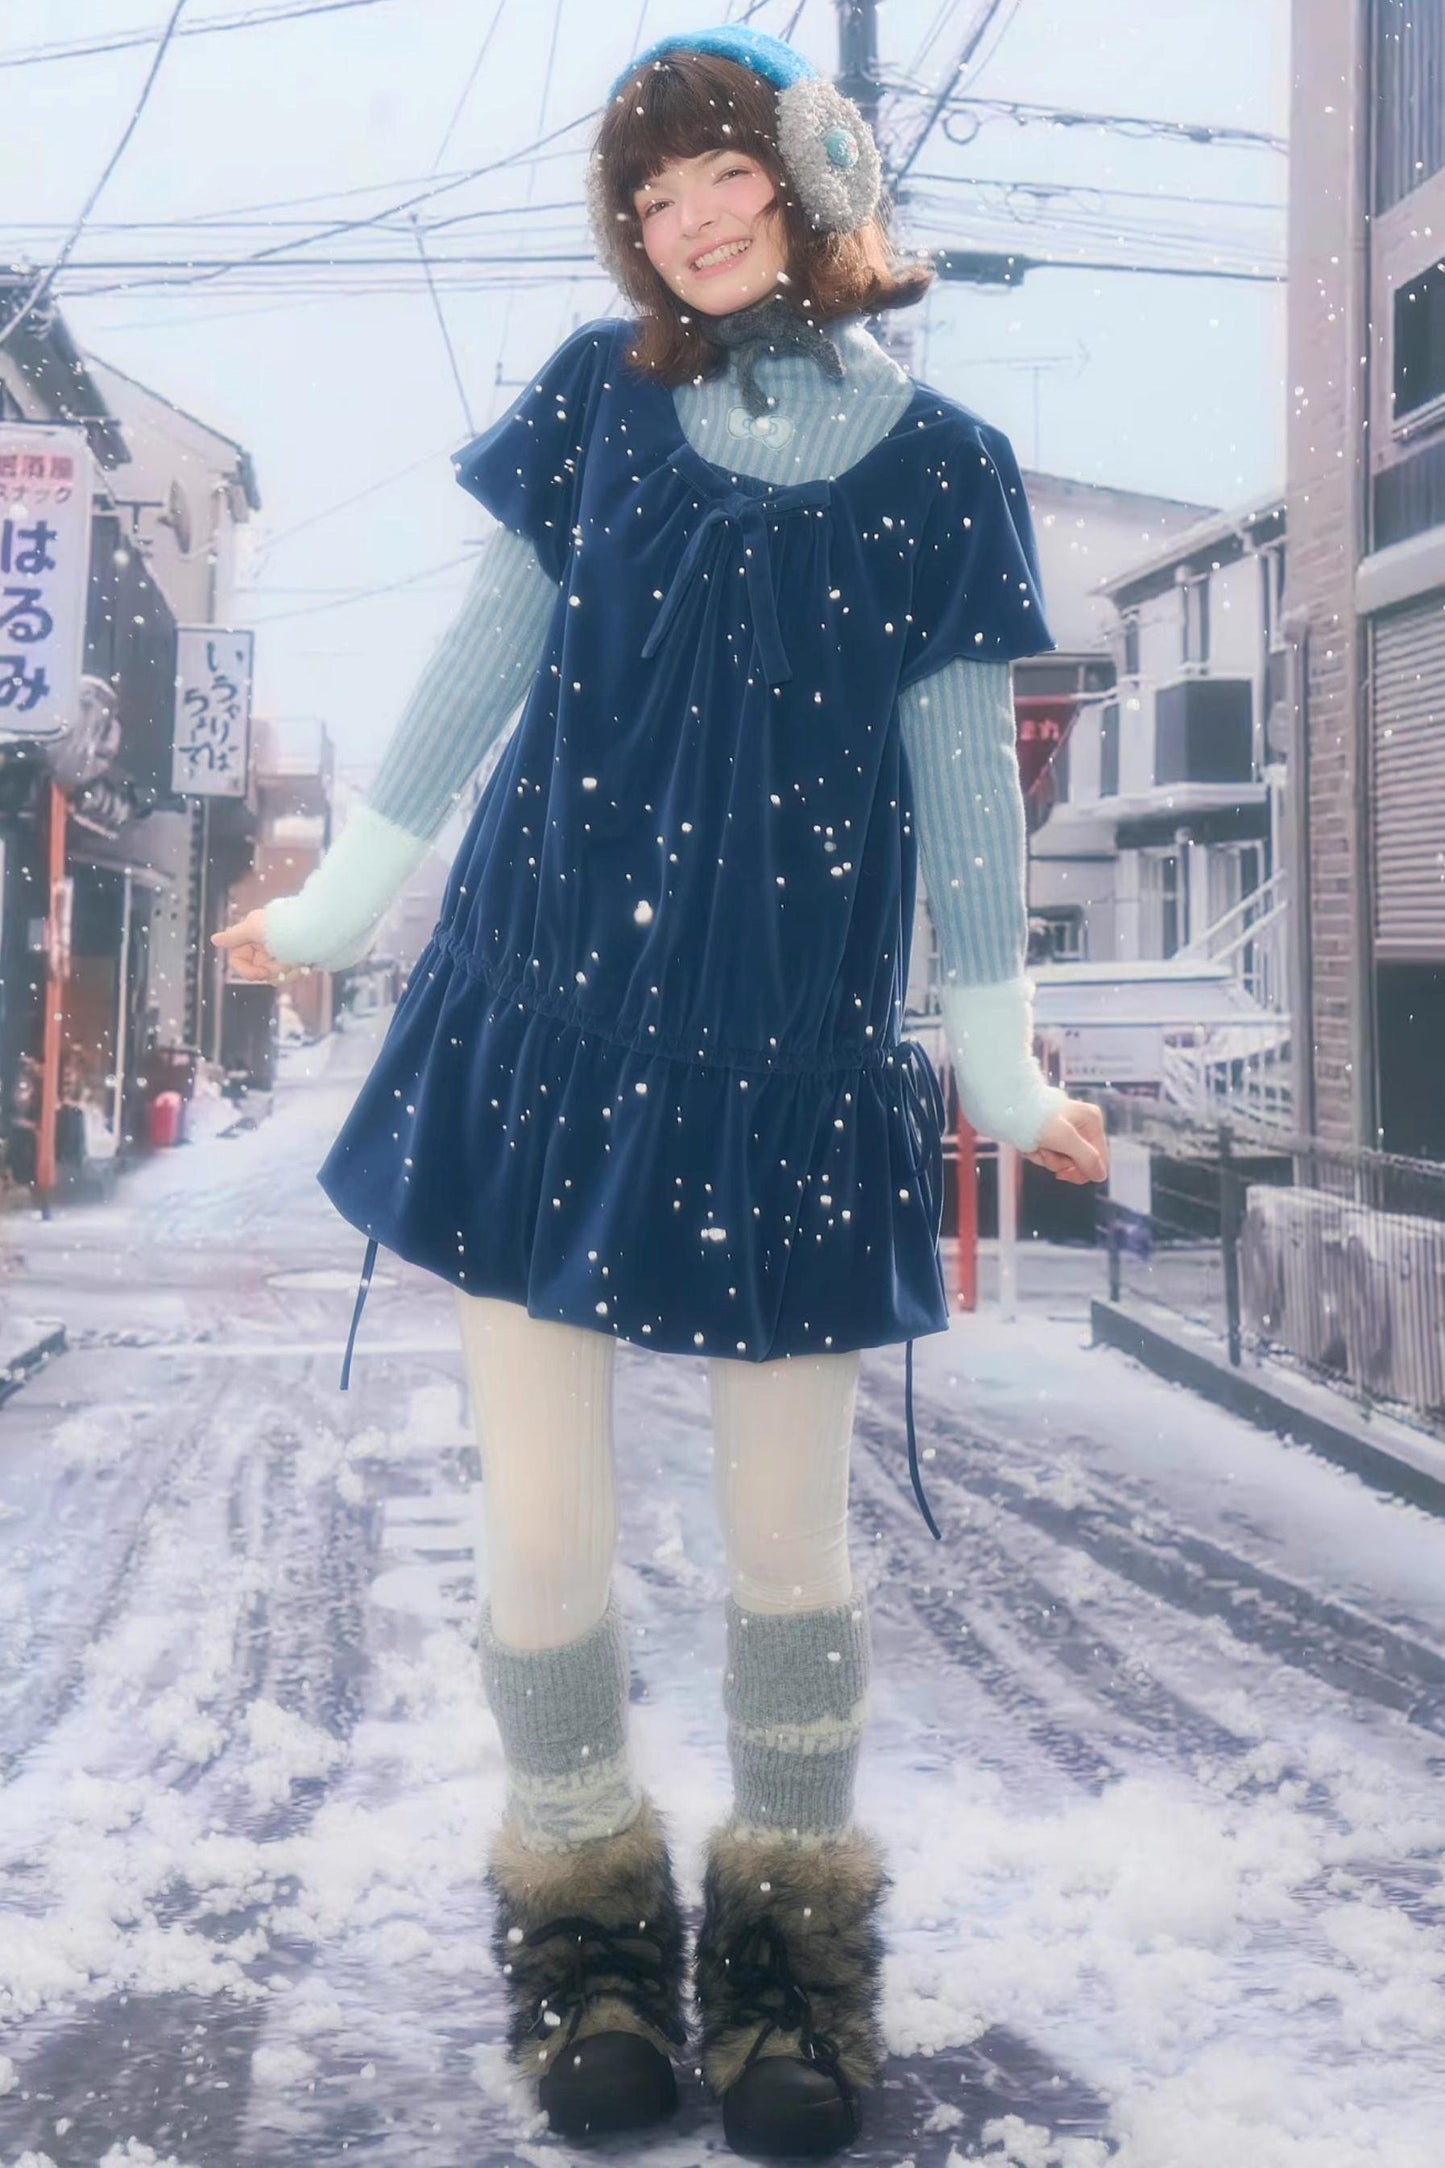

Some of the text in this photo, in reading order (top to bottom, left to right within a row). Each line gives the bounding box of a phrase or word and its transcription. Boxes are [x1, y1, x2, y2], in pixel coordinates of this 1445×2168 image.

[0, 455, 73, 478] 居酒屋
[0, 519, 57, 711] はるみ
